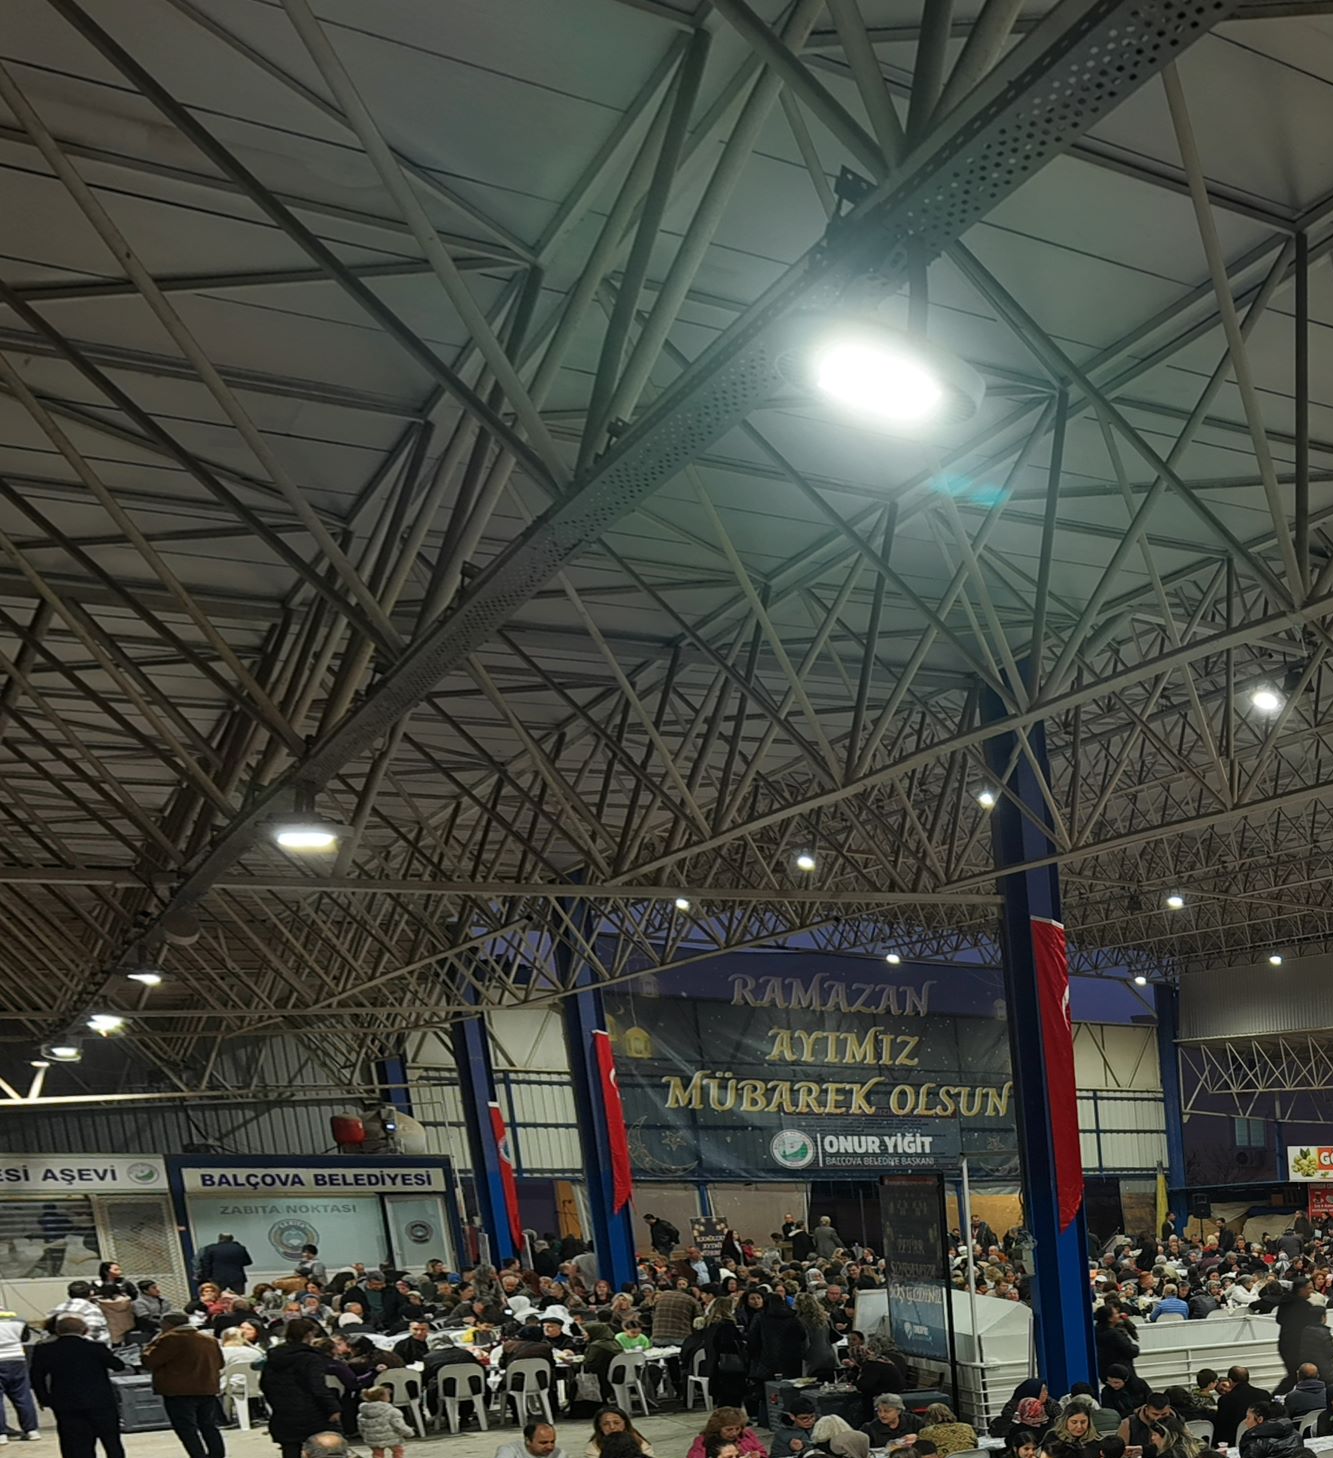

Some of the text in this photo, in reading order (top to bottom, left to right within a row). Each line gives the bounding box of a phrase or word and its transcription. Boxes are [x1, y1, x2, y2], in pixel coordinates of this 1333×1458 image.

[728, 972, 937, 1017] RAMAZAN
[766, 1025, 919, 1066] AYIMIZ
[662, 1070, 1013, 1117] MÜBAREK OLSUN
[824, 1132, 933, 1153] ONUR YİĞİT
[42, 1165, 117, 1185] AŞEVİ
[201, 1170, 432, 1190] BALÇOVA BELEDİYESİ
[220, 1204, 357, 1215] ZABITA NOKTASI
